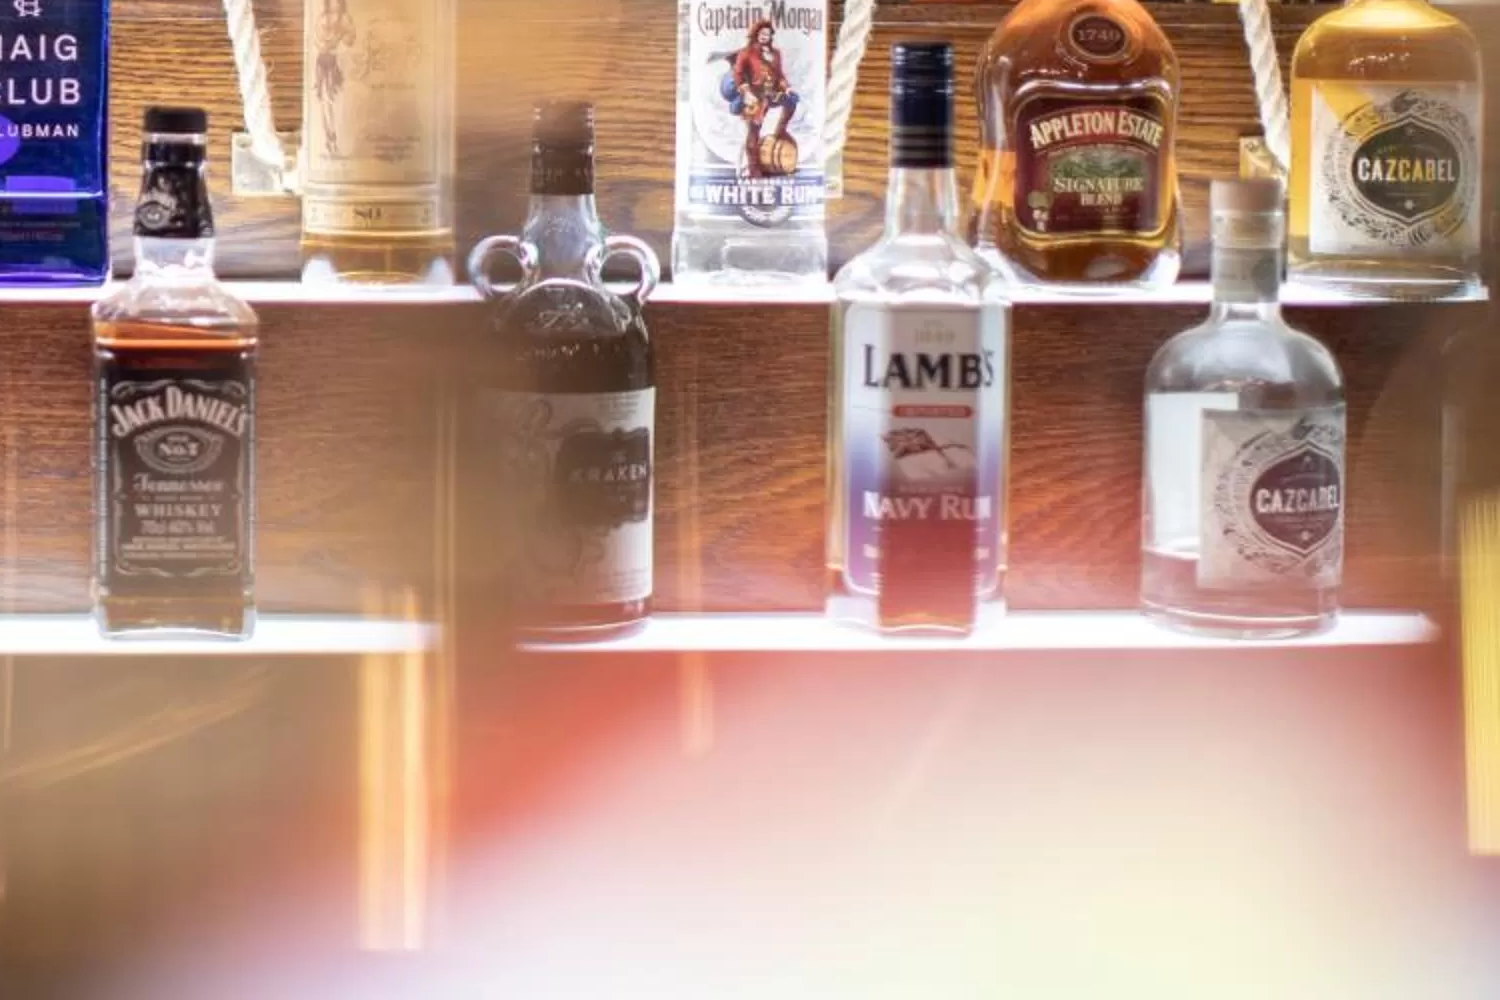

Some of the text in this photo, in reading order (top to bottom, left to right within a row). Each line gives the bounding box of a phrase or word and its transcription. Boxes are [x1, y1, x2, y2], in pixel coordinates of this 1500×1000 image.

[696, 0, 763, 36] Captain
[1029, 110, 1164, 149] APPLETON ESTATE
[1356, 156, 1457, 183] CAZCABEL
[705, 185, 777, 205] WHITE
[110, 396, 166, 437] JACK
[133, 502, 223, 518] WHISKEY
[862, 491, 934, 520] NAVY
[1255, 484, 1340, 515] CAZCABEL
